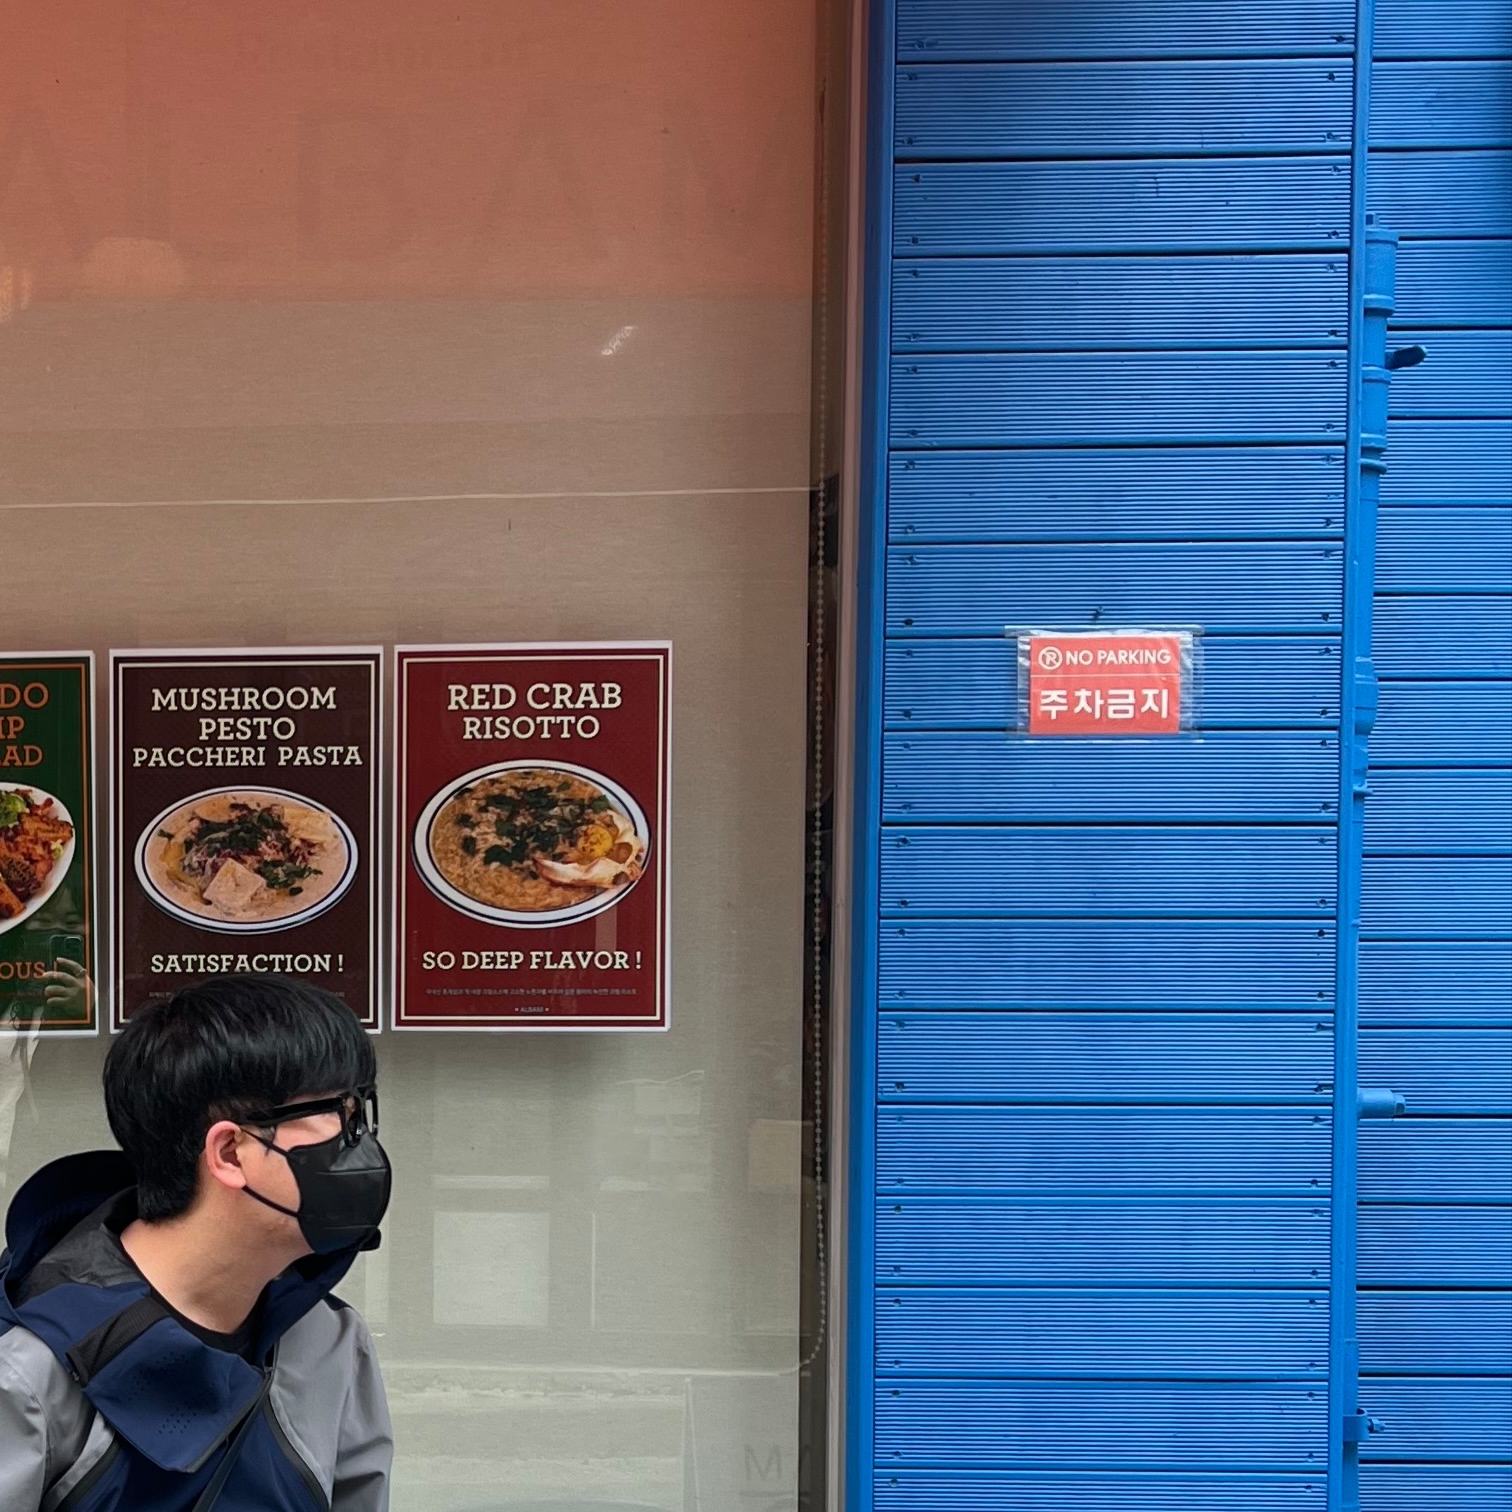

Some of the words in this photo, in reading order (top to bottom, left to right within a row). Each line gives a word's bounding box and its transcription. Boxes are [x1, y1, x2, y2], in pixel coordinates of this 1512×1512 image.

[1066, 650, 1094, 665] NO
[1097, 649, 1172, 665] PARKING
[151, 687, 337, 711] MUSHROOM
[447, 684, 517, 711] RED
[527, 682, 623, 710] CRAB
[1039, 688, 1169, 720] 주차금지
[199, 717, 296, 740] PESTO
[462, 715, 601, 740] RISOTTO
[133, 747, 266, 767] PACCHERI
[278, 746, 363, 766] PASTA
[422, 950, 455, 970] SO
[461, 950, 523, 970] DEEP
